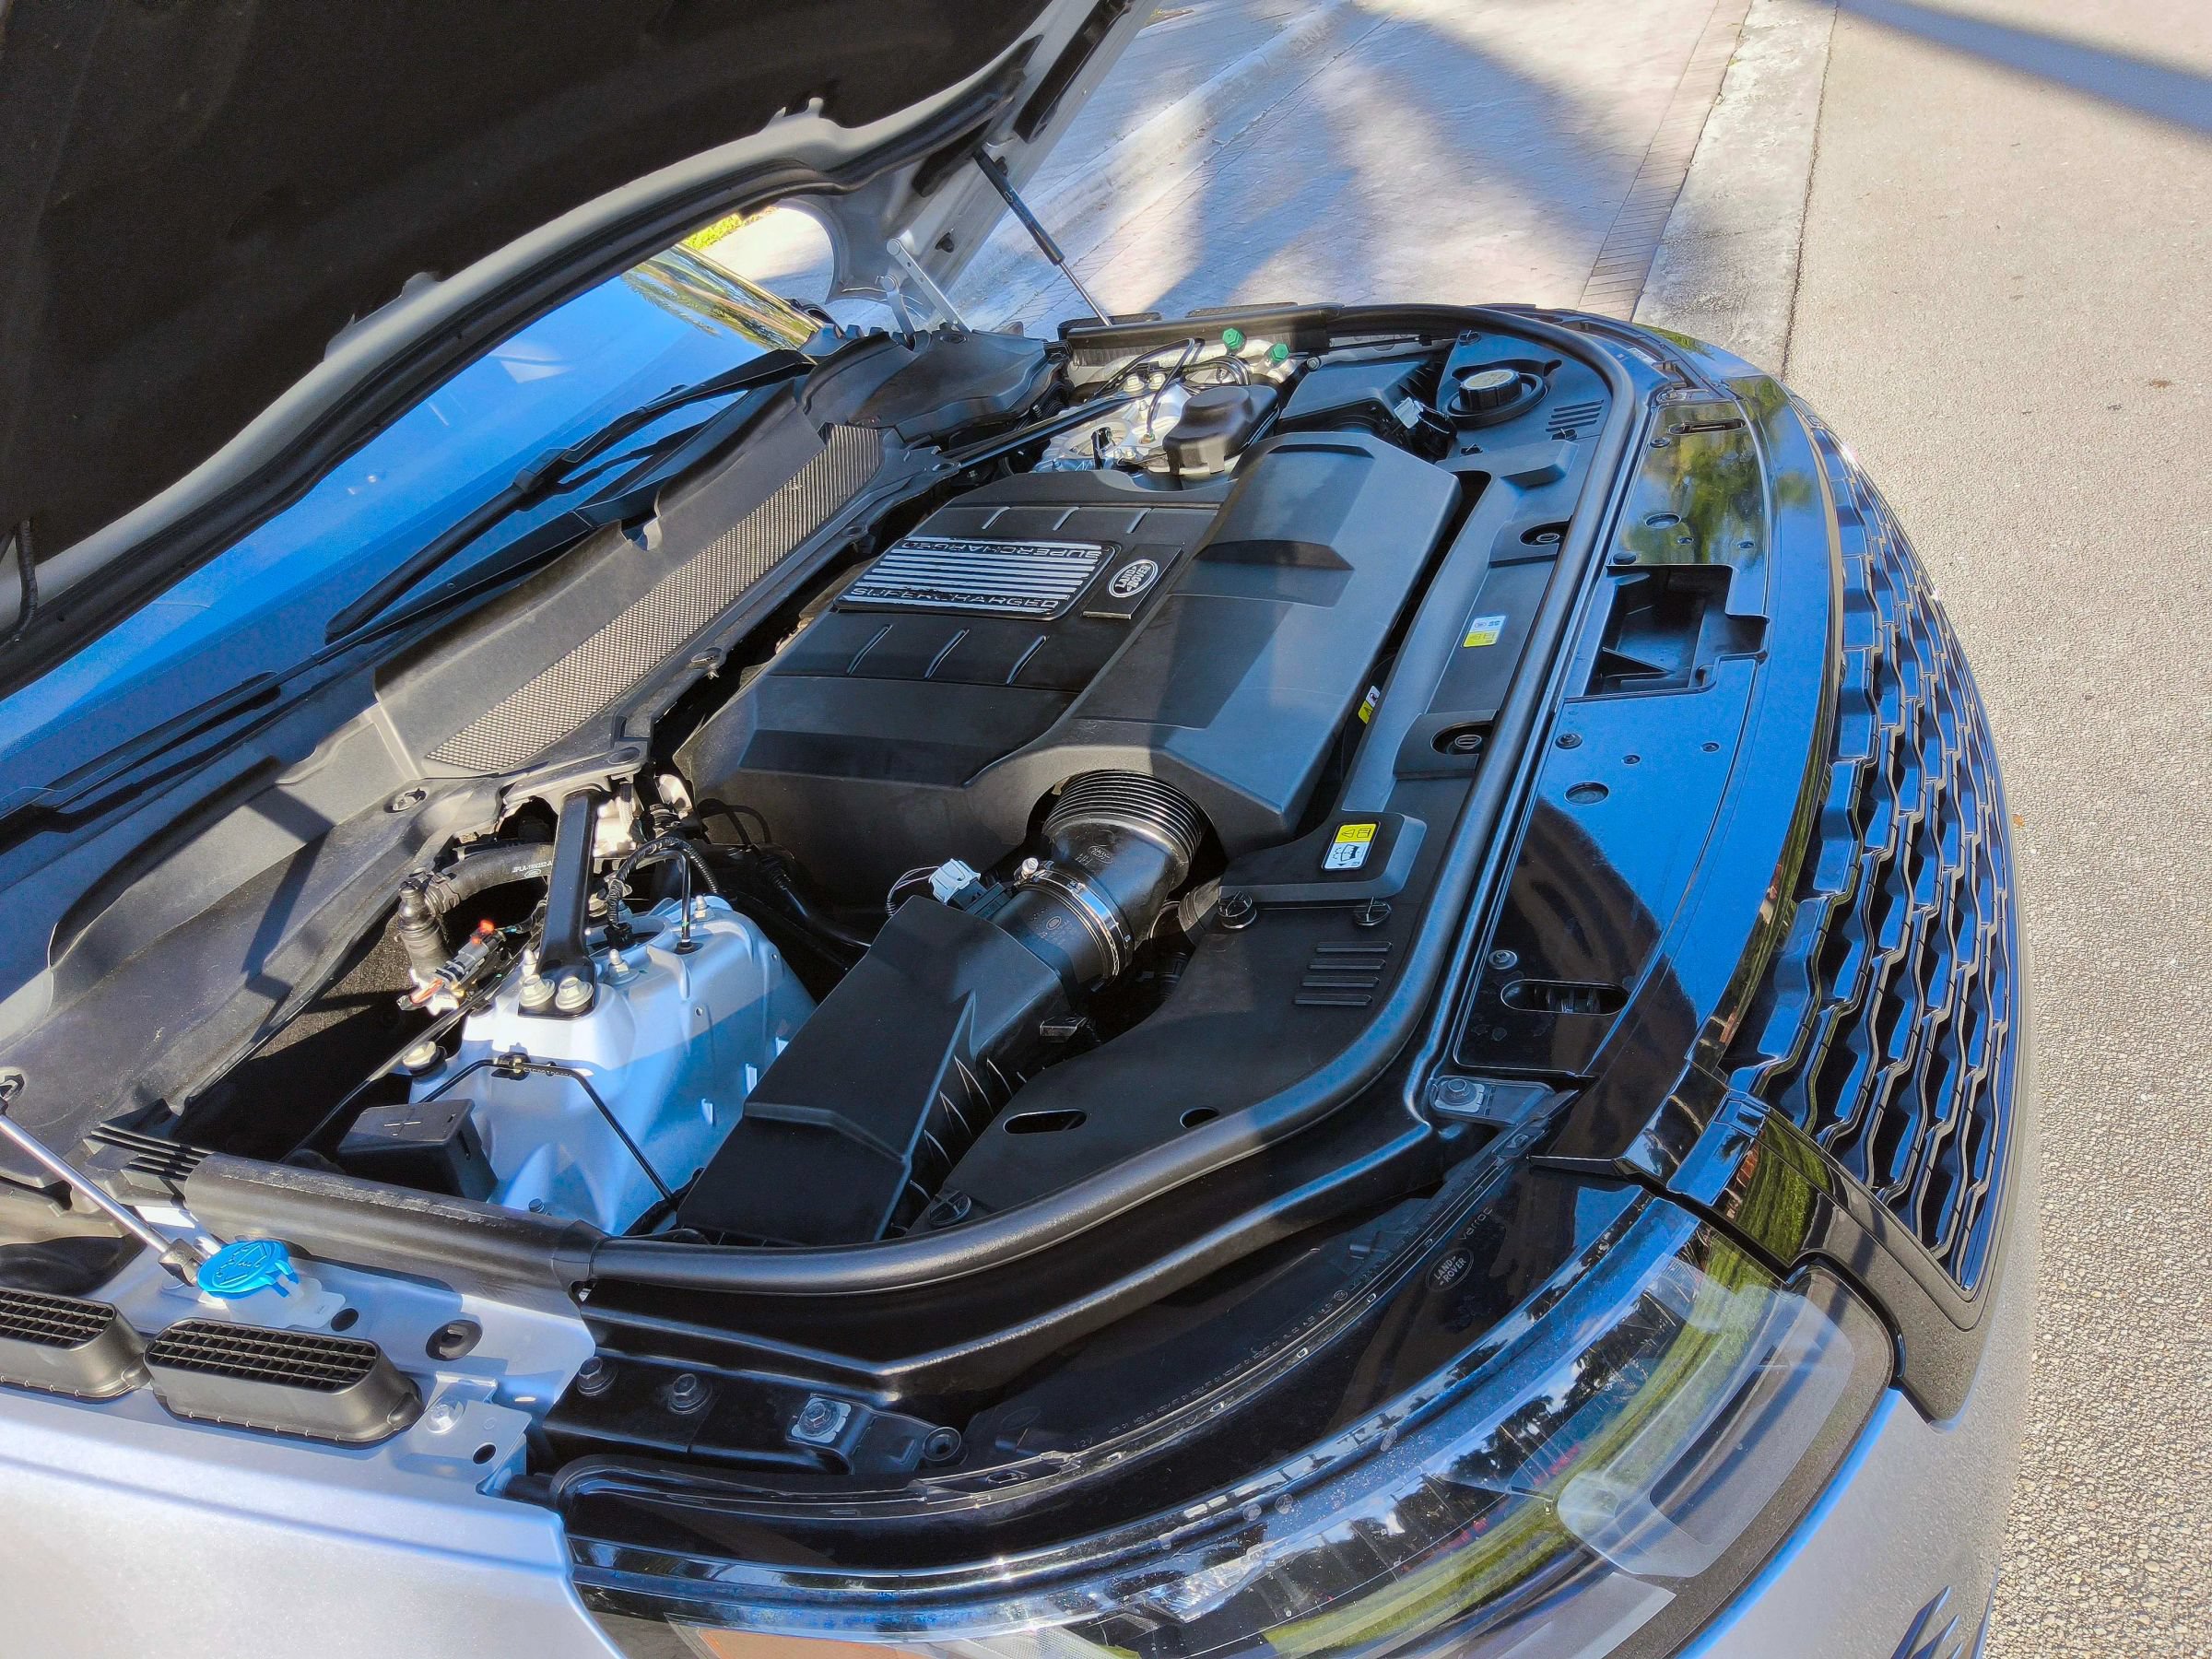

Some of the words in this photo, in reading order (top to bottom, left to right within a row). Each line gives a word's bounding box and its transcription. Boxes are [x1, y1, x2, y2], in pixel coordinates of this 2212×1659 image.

[901, 541, 1102, 559] SUPERCHARGED
[1114, 566, 1137, 588] LAND
[1126, 564, 1152, 592] ROVER
[850, 586, 1059, 609] SUPERCHARGED
[1433, 1255, 1456, 1280] LAND
[1441, 1257, 1467, 1283] ROVER
